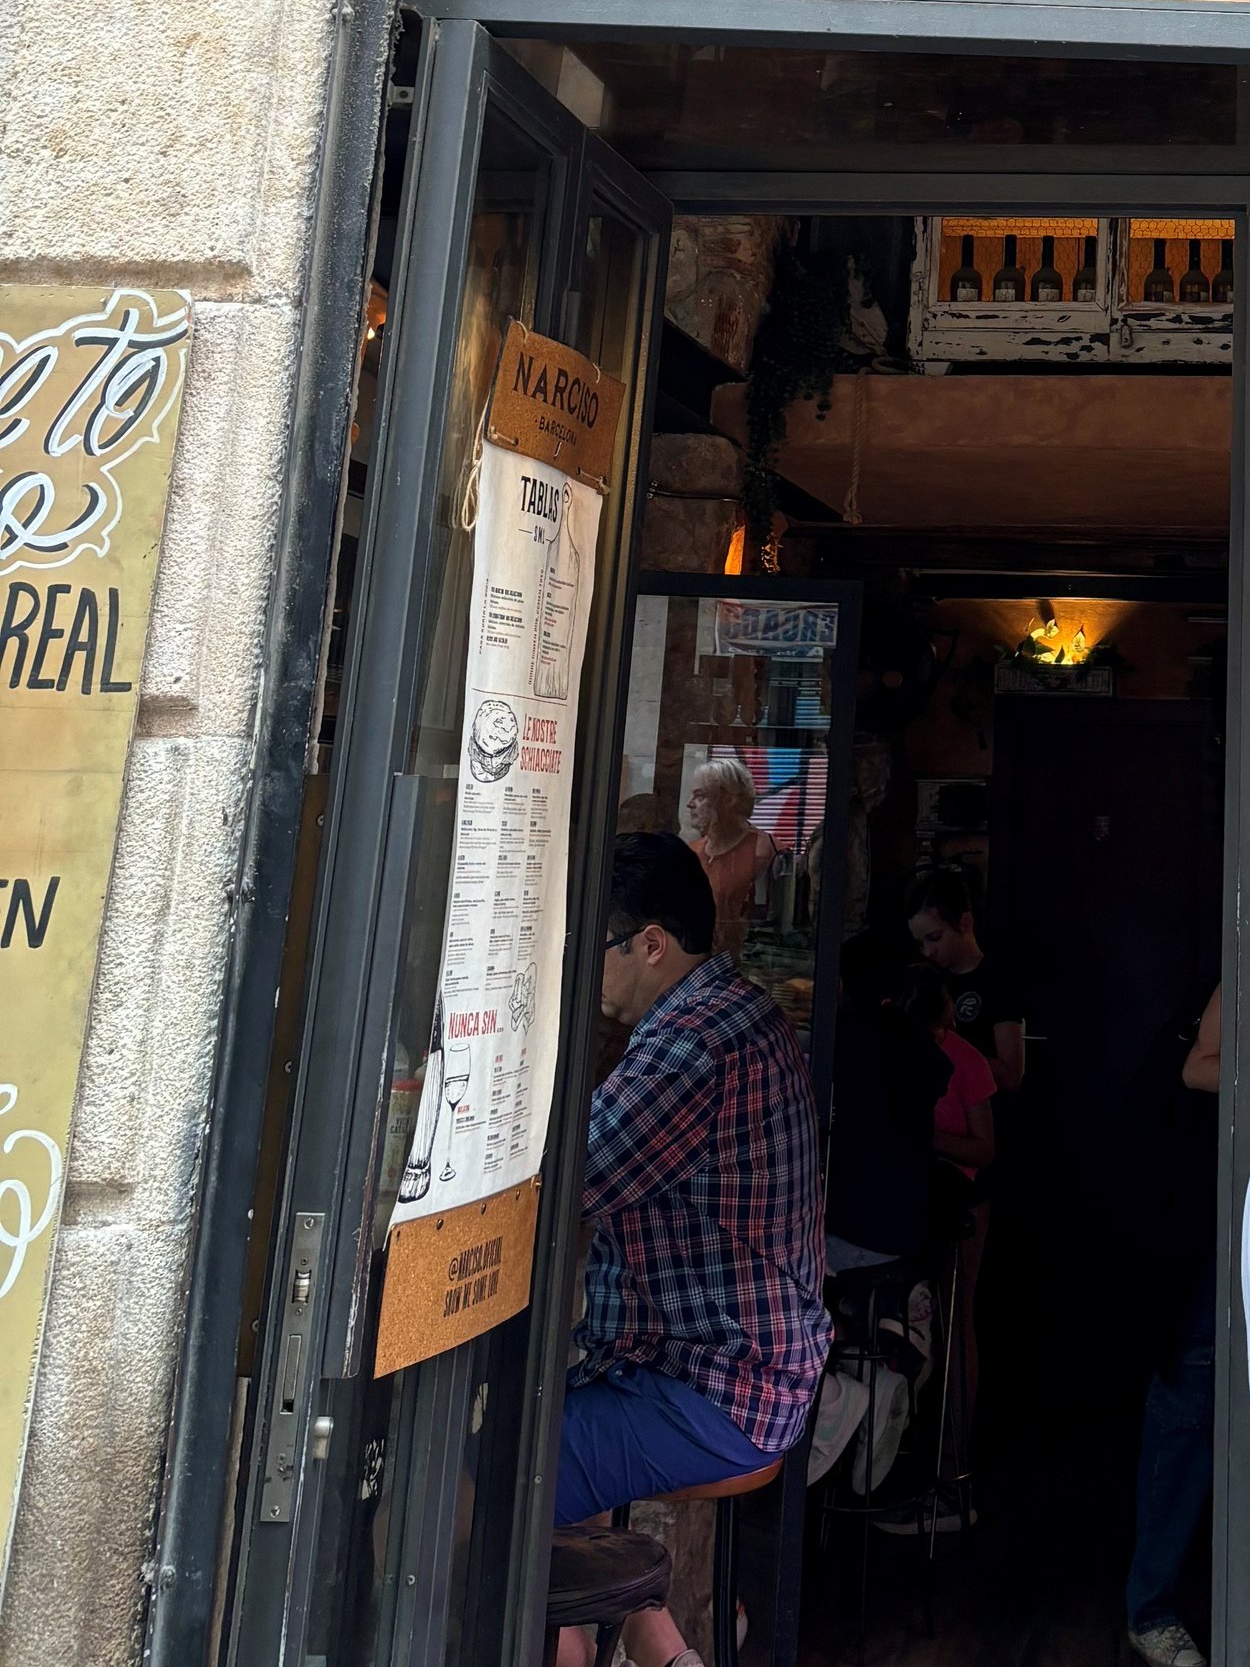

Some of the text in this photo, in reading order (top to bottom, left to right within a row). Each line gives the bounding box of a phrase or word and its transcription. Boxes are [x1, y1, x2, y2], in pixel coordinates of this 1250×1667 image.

[44, 308, 189, 457] to
[512, 351, 599, 429] NARCISO
[521, 475, 559, 523] TABLAS
[0, 581, 132, 695] REAL
[448, 1011, 480, 1040] NUNCA
